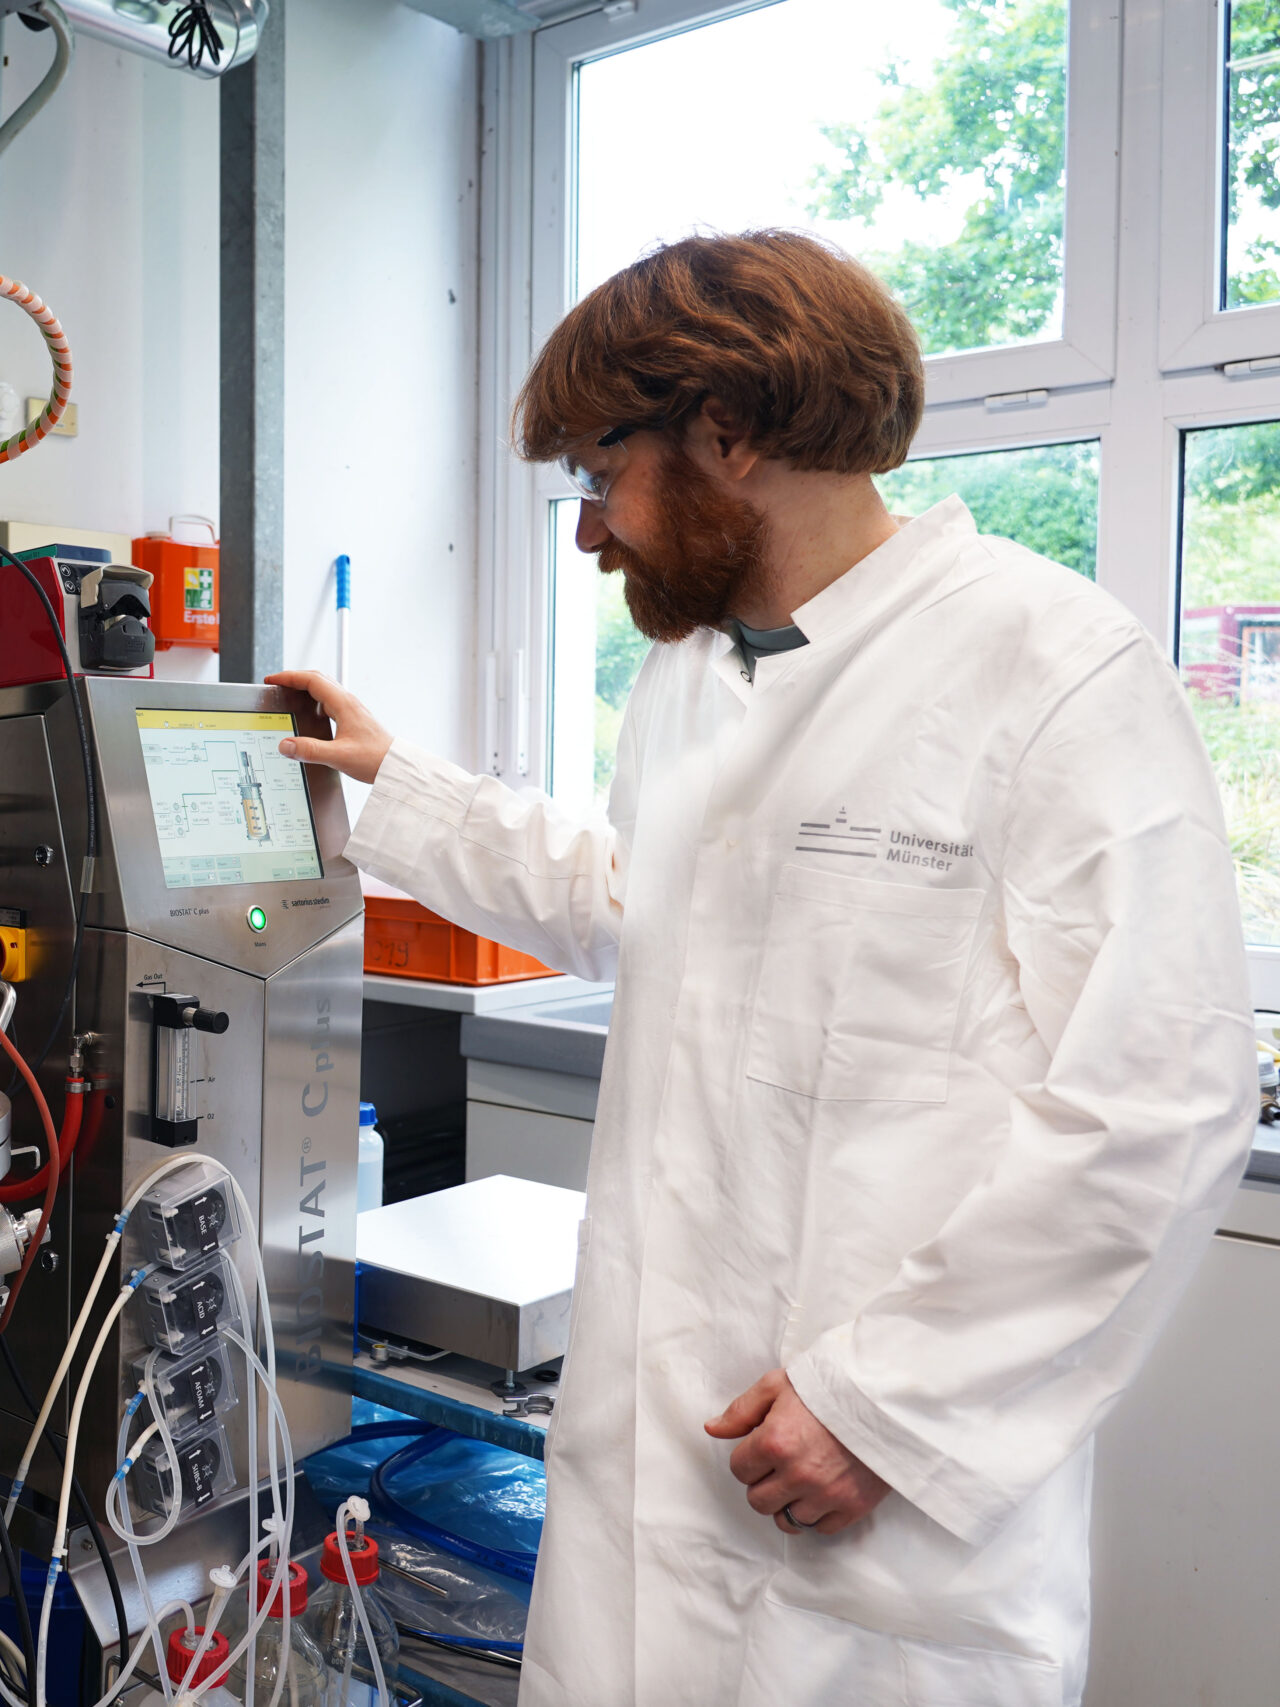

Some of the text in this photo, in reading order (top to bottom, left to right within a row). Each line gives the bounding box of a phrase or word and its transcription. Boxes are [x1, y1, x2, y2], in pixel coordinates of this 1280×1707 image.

[183, 610, 216, 625] Erste
[889, 829, 974, 858] Universität
[886, 848, 953, 872] Münster
[301, 1082, 329, 1118] C
[315, 999, 335, 1073] plus
[198, 1214, 209, 1236] BASE
[196, 1300, 206, 1320] ACID
[194, 1381, 205, 1410] AFOAM
[191, 1462, 203, 1491] SUBS-B
